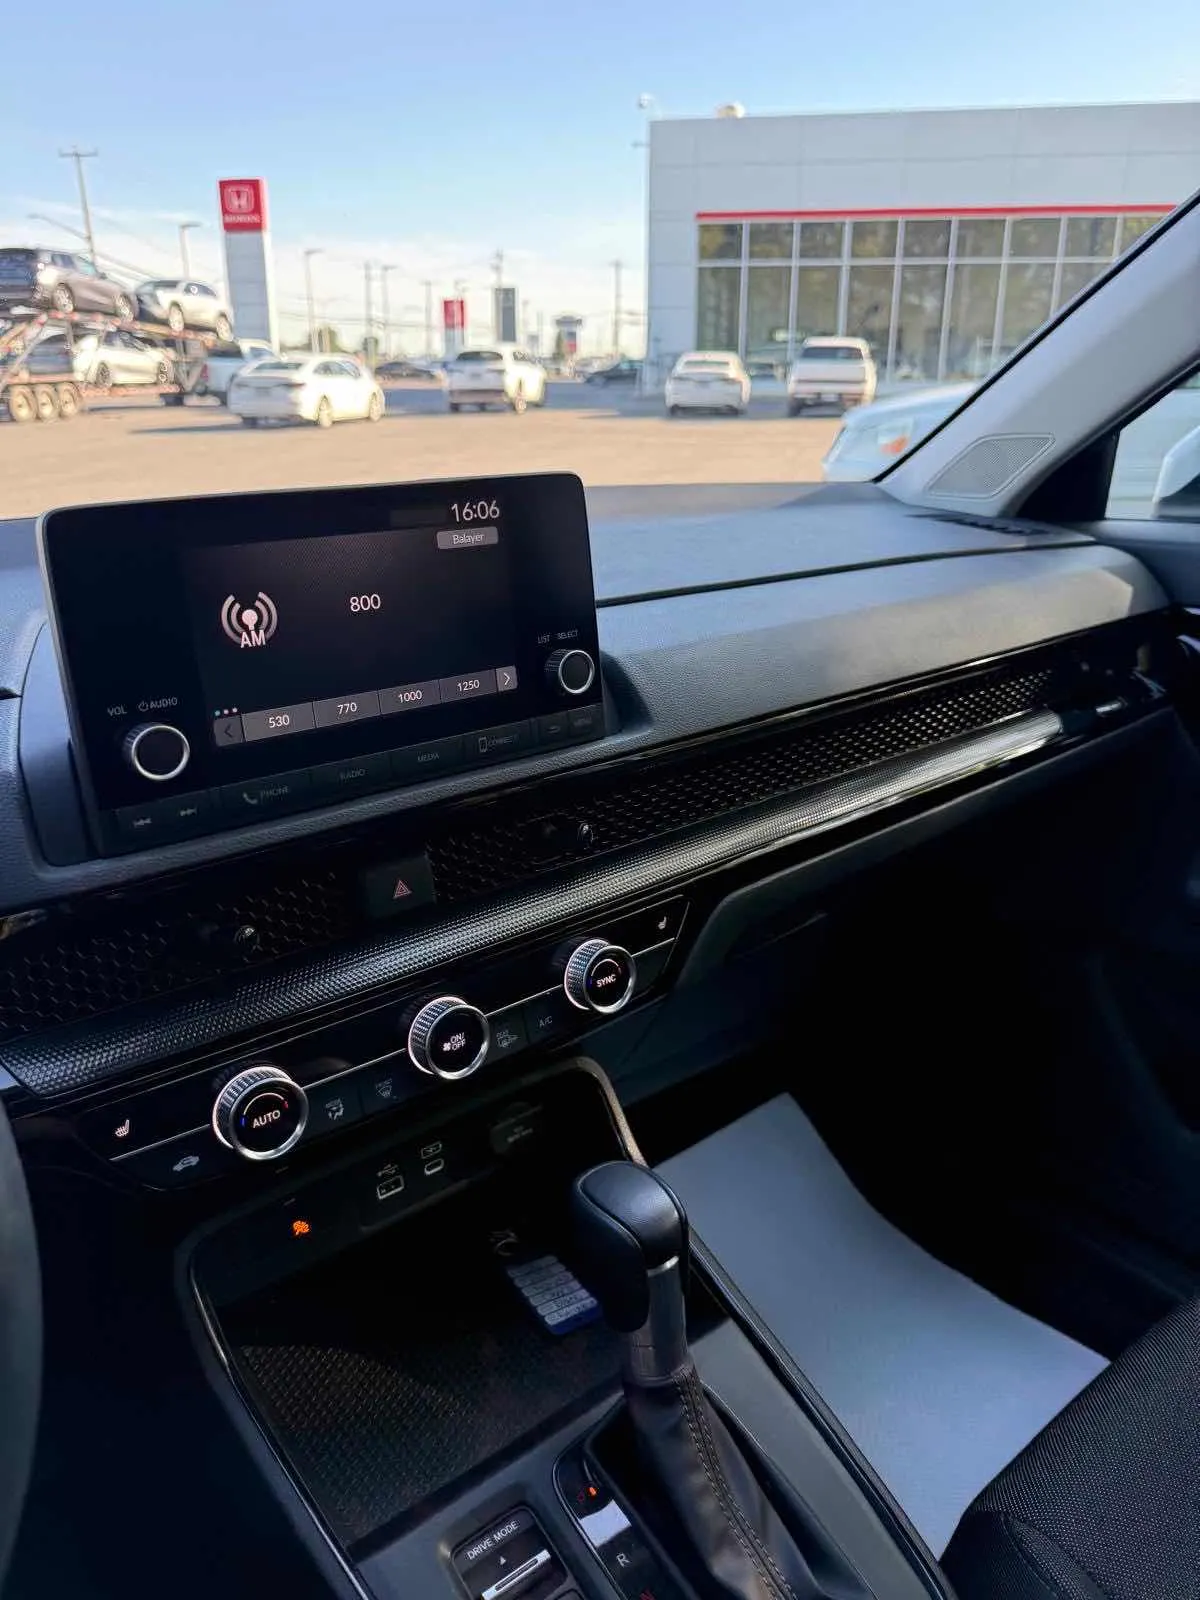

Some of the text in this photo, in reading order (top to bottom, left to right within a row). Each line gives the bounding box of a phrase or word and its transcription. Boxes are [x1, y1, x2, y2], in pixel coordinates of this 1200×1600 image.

[451, 500, 500, 522] 16:06
[453, 531, 485, 545] Balayer
[350, 593, 382, 612] 800
[240, 629, 266, 648] AM
[537, 629, 579, 645] LIST SELECT
[457, 679, 480, 692] 1250
[398, 689, 423, 703] 1000
[107, 696, 178, 717] VOL AUDIO
[337, 702, 358, 715] 770
[268, 714, 290, 728] 530
[596, 973, 617, 989] SYNC
[451, 1038, 467, 1051] OFF
[252, 1109, 281, 1129] AUTO
[467, 1519, 520, 1561] DRIVE MODE
[616, 1553, 632, 1568] R
